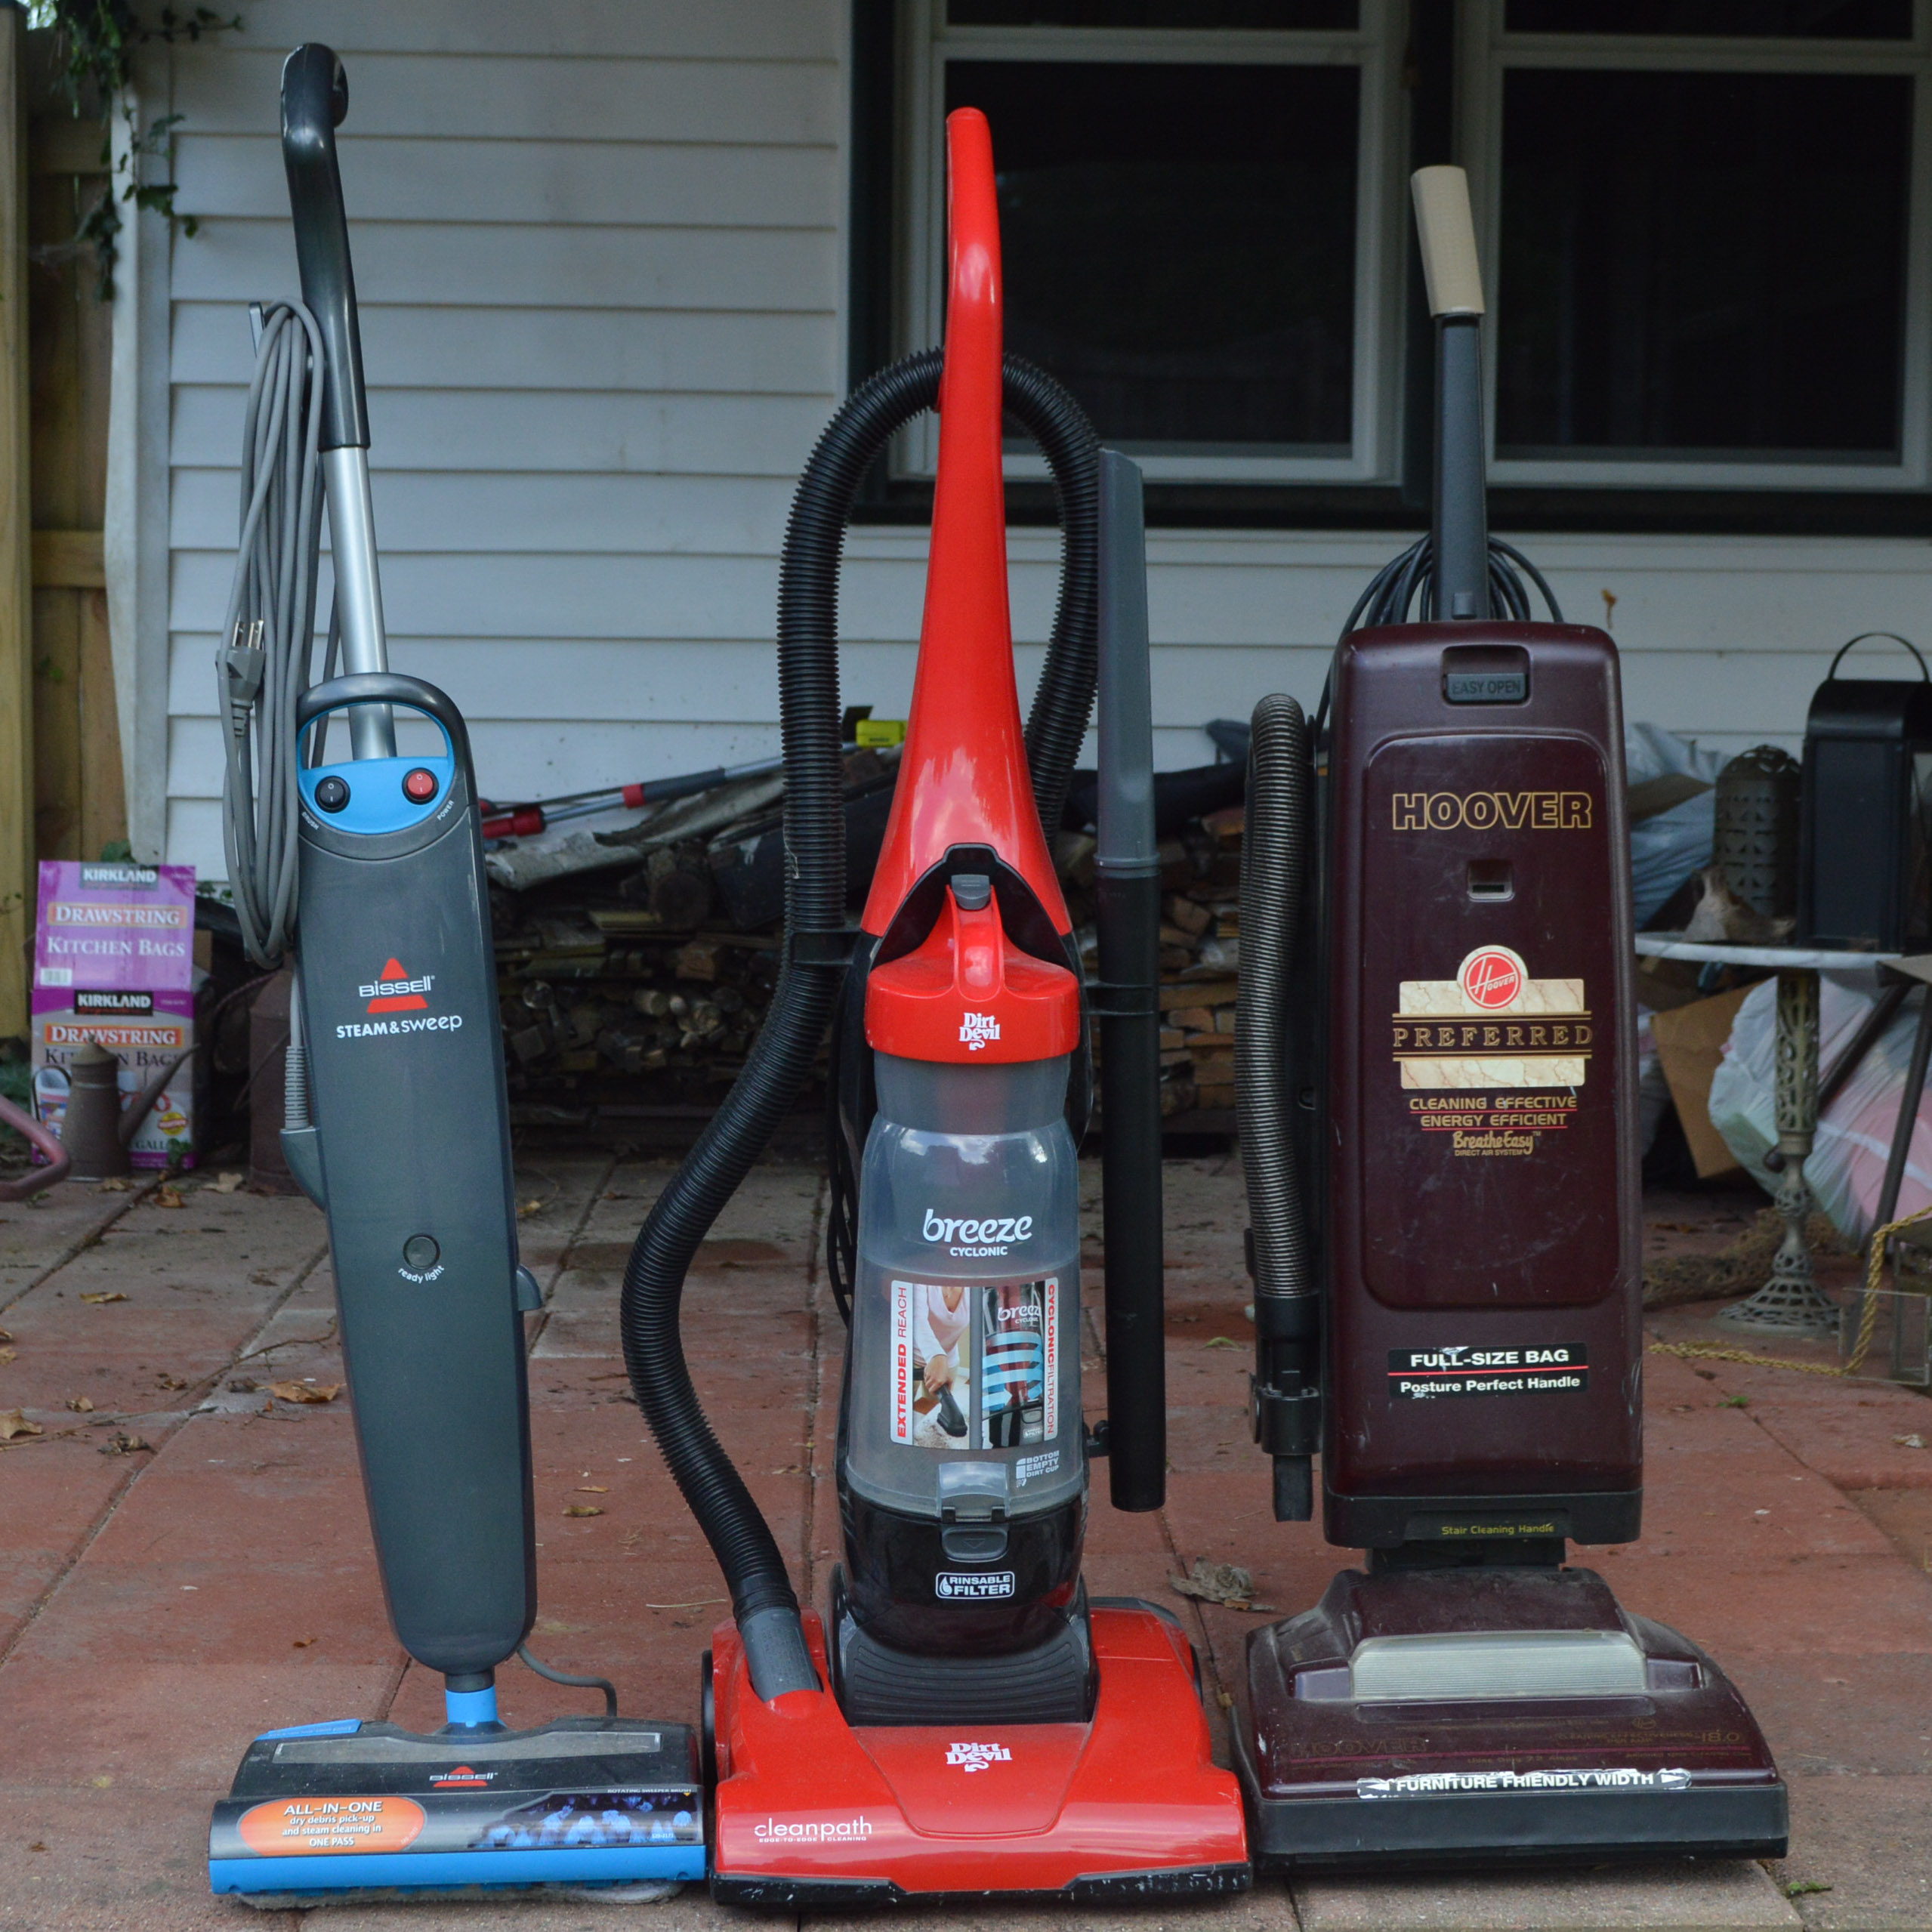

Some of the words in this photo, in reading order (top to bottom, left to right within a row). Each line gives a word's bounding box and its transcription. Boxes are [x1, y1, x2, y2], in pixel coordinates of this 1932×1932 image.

[1452, 681, 1484, 695] EASY
[1486, 680, 1520, 693] OPEN
[437, 799, 455, 821] POWER
[1393, 792, 1592, 830] HOOVER
[83, 869, 156, 882] KIRKLAND
[56, 906, 181, 925] DRAWSTRING
[47, 937, 133, 955] KITCHEN
[137, 939, 185, 956] BAGS
[77, 993, 151, 1008] KIRKLAND
[964, 1012, 995, 1028] Dirt
[51, 1026, 177, 1045] DRAWSTRING
[958, 1023, 1001, 1042] Devil
[1393, 1026, 1594, 1048] PREFERRED
[1409, 1097, 1487, 1110] CLEANING
[1495, 1096, 1577, 1110] EFFECTIVE
[1421, 1114, 1483, 1127] ENERGY
[1489, 1113, 1567, 1125] EFFICIENT
[922, 1208, 1032, 1244] breeze
[949, 1246, 1008, 1257] CYCLONIC
[397, 1267, 424, 1284] ready
[424, 1265, 445, 1282] light
[897, 1286, 907, 1338] REACH
[1410, 1351, 1519, 1367] FULL-SIZE
[1525, 1349, 1569, 1363] BAG
[897, 1344, 907, 1437] EXTENDED
[1400, 1381, 1461, 1393] Posture
[1466, 1378, 1523, 1391] Perfect
[1527, 1375, 1581, 1389] Handle
[1026, 1450, 1060, 1464] BOTTOM
[1026, 1457, 1059, 1471] EMPTY
[1026, 1468, 1044, 1477] DIRT
[1045, 1464, 1059, 1474] CUP
[1442, 1526, 1468, 1535] Stair
[1471, 1525, 1515, 1535] Cleaning
[1519, 1524, 1555, 1533] Handle
[949, 1575, 1011, 1585] RINSABLE
[954, 1584, 1011, 1596] FILTER
[949, 1742, 1001, 1752] Dirt
[944, 1748, 1013, 1765] Devil
[1397, 1776, 1498, 1792] FURNITURE
[1502, 1773, 1590, 1788] FRIENDLY
[1596, 1773, 1654, 1785] WIDTH
[284, 1801, 383, 1816] ALL-IN-ONE
[290, 1816, 305, 1826] dry
[308, 1815, 336, 1824] debris
[339, 1814, 375, 1825] pick-up
[282, 1826, 300, 1836] and
[302, 1826, 329, 1835] steam
[332, 1825, 370, 1836] cleaning
[372, 1824, 382, 1832] in
[754, 1816, 872, 1841] cleanpath
[309, 1838, 329, 1847] ONE
[332, 1837, 354, 1847] PASS
